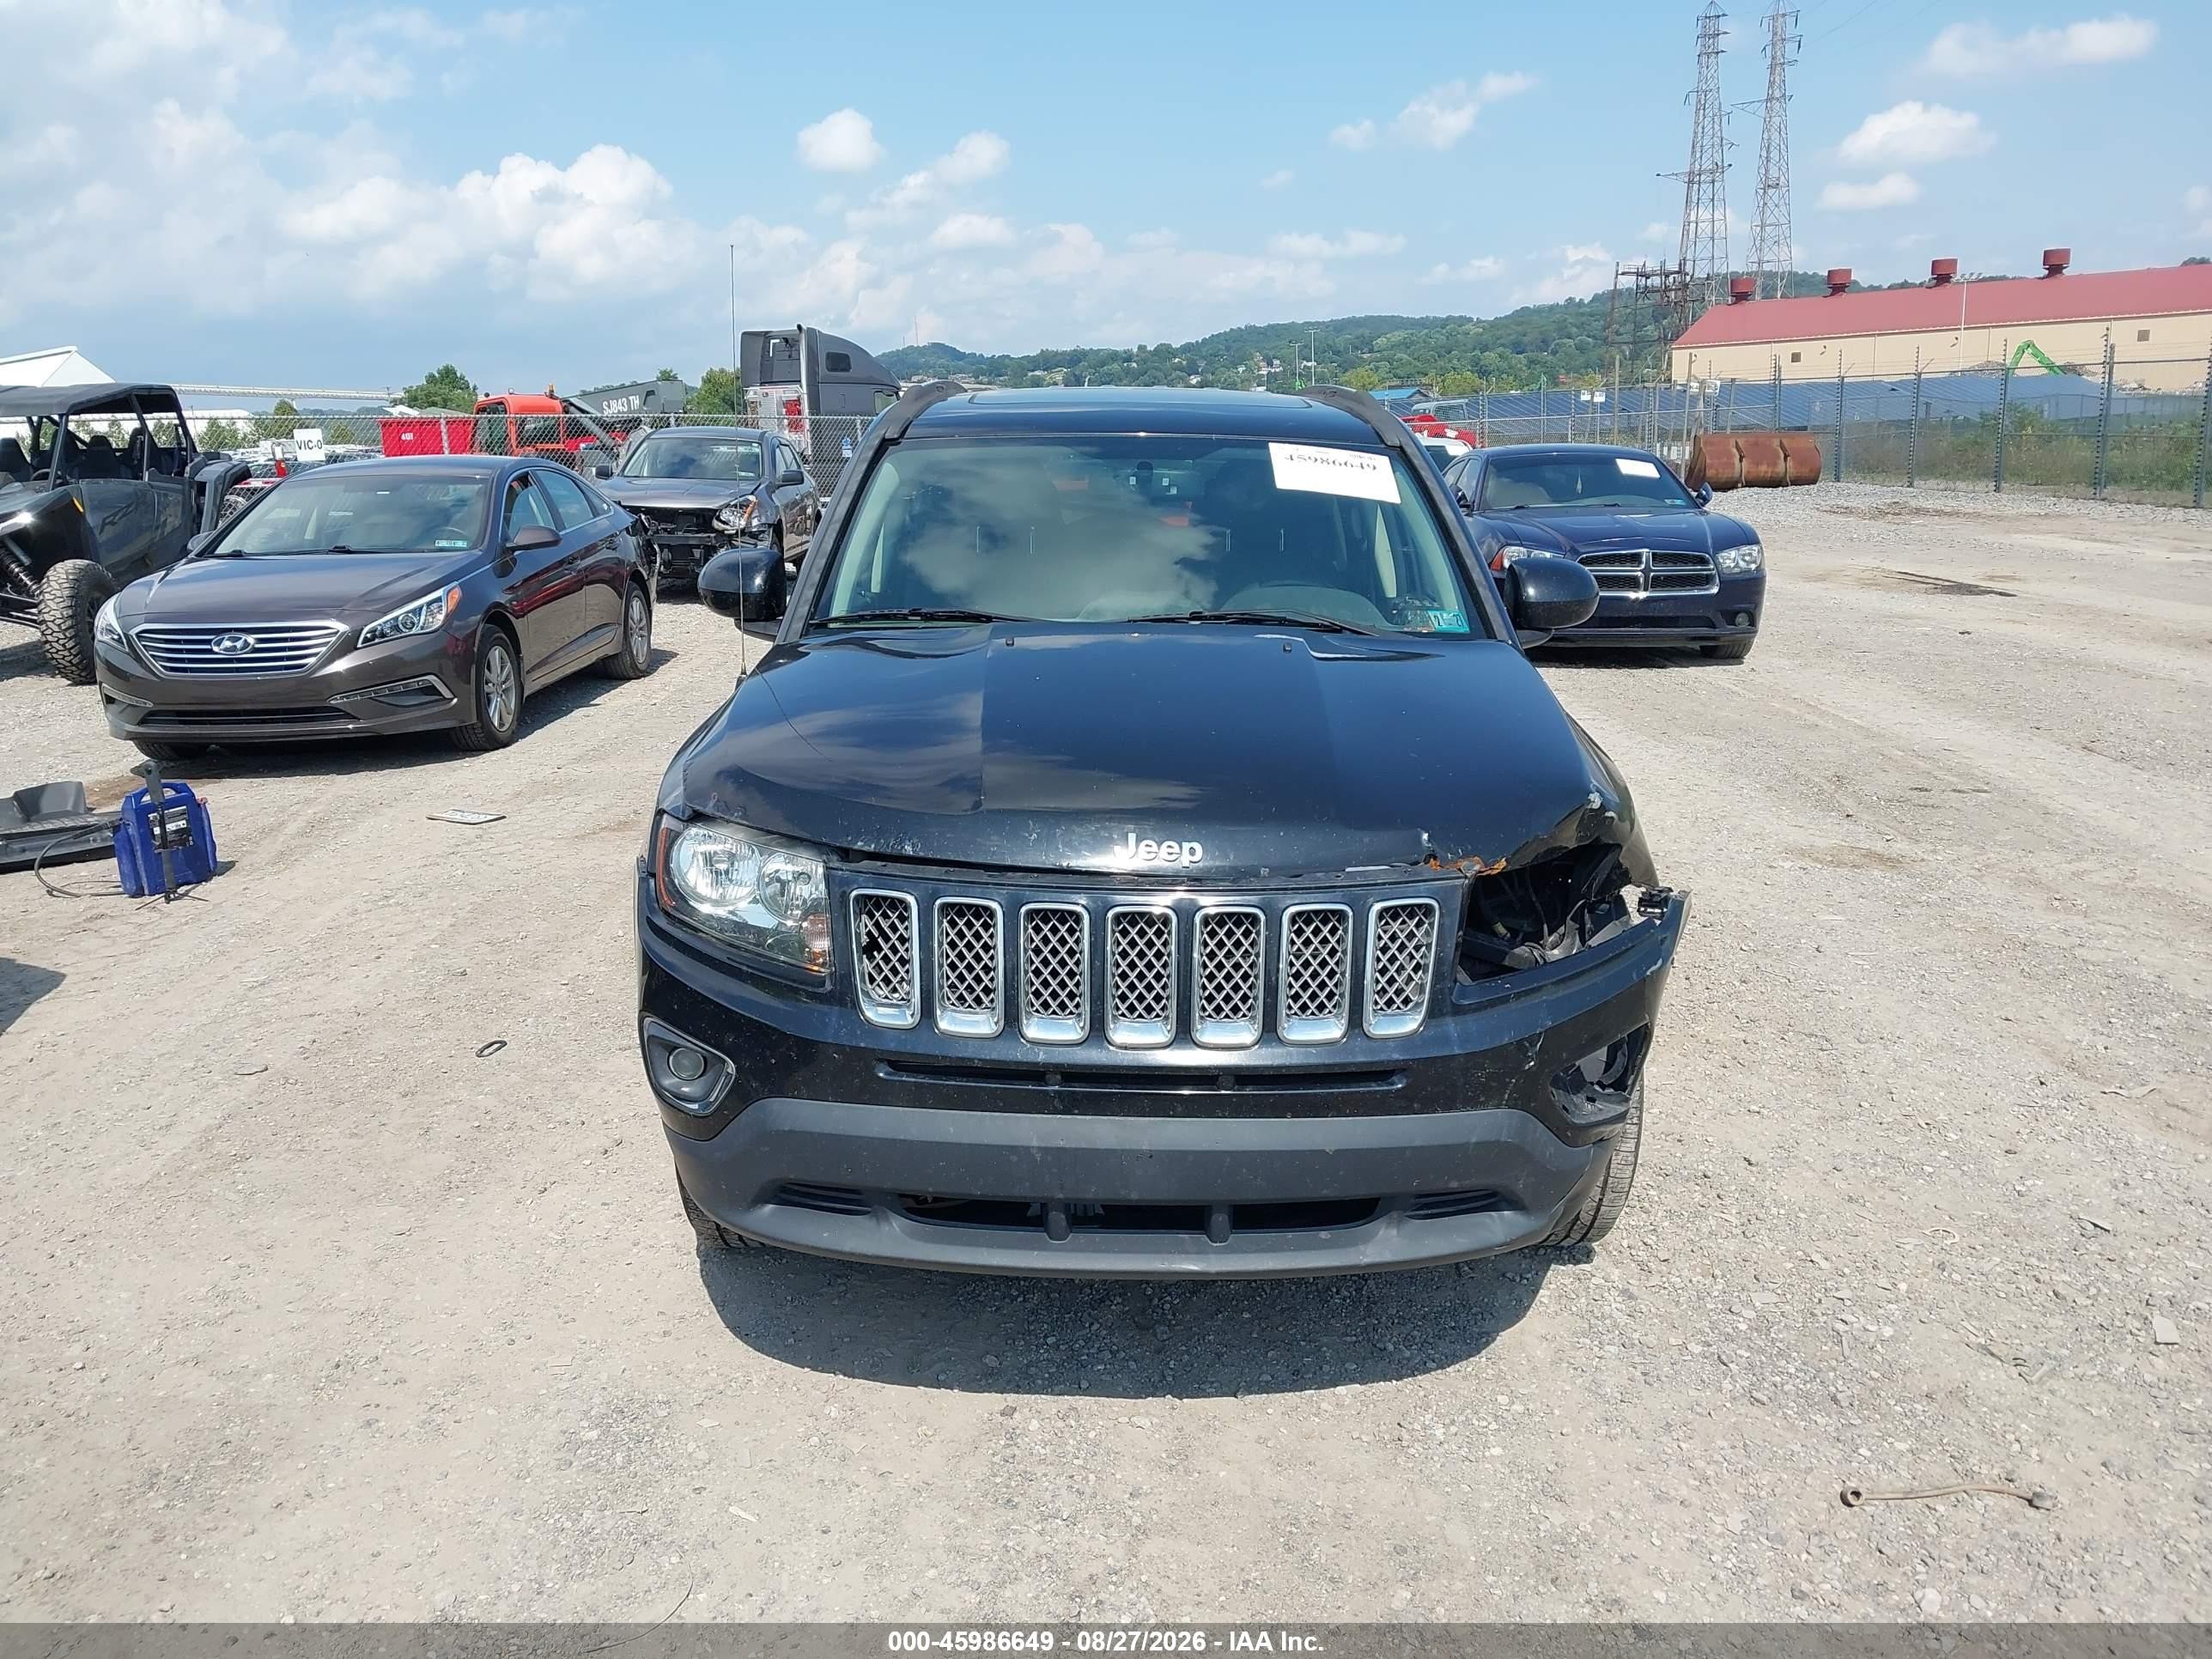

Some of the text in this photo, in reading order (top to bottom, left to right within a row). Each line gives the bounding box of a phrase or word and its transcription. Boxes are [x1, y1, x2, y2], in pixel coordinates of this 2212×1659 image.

[603, 395, 640, 415] SJ843 TH
[1113, 832, 1203, 868] Jeep
